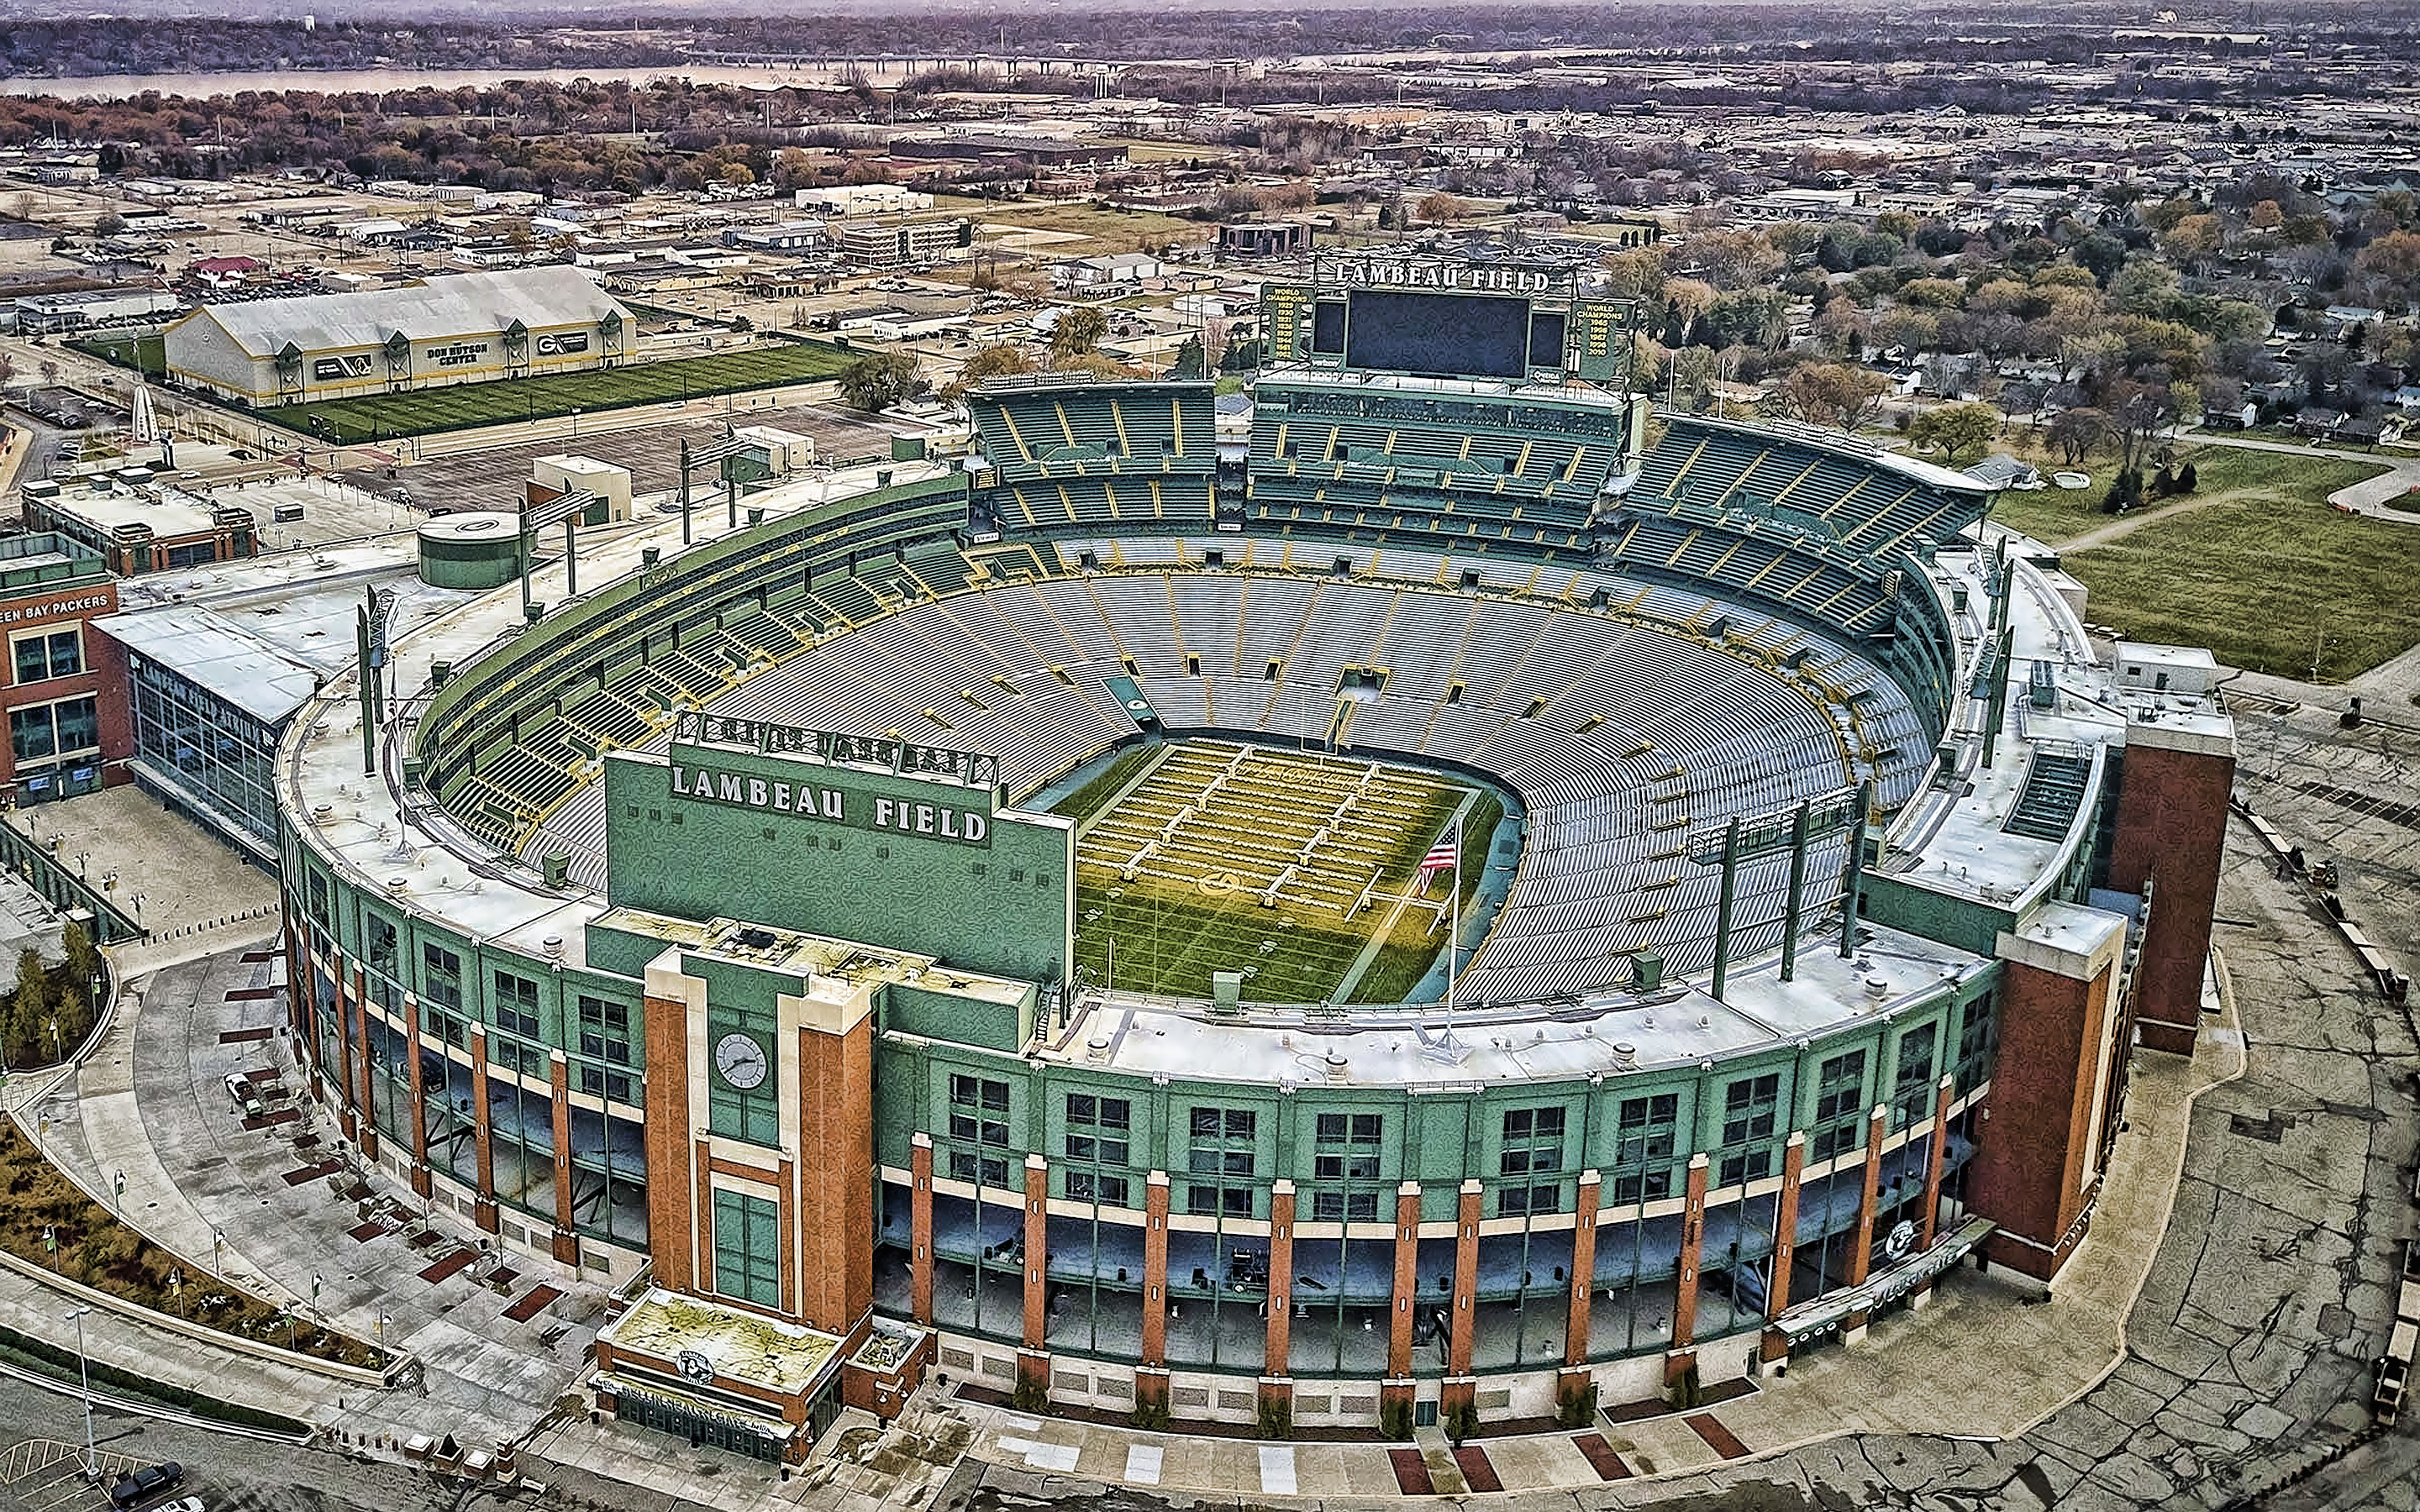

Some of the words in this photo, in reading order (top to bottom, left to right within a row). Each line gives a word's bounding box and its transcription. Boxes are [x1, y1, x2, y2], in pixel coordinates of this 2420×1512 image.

[1336, 263, 1459, 287] LAMBEAU
[1471, 269, 1550, 291] FIELD
[1265, 294, 1308, 302] CHAMPIONS
[1576, 311, 1623, 319] CHAMPIONS
[427, 348, 448, 359] DON
[449, 344, 488, 356] HUTSON
[439, 354, 477, 366] CENTER
[25, 605, 49, 618] BAY
[52, 595, 108, 614] PACKERS
[671, 765, 844, 820] LAMBEAU
[875, 797, 988, 843] FIELD
